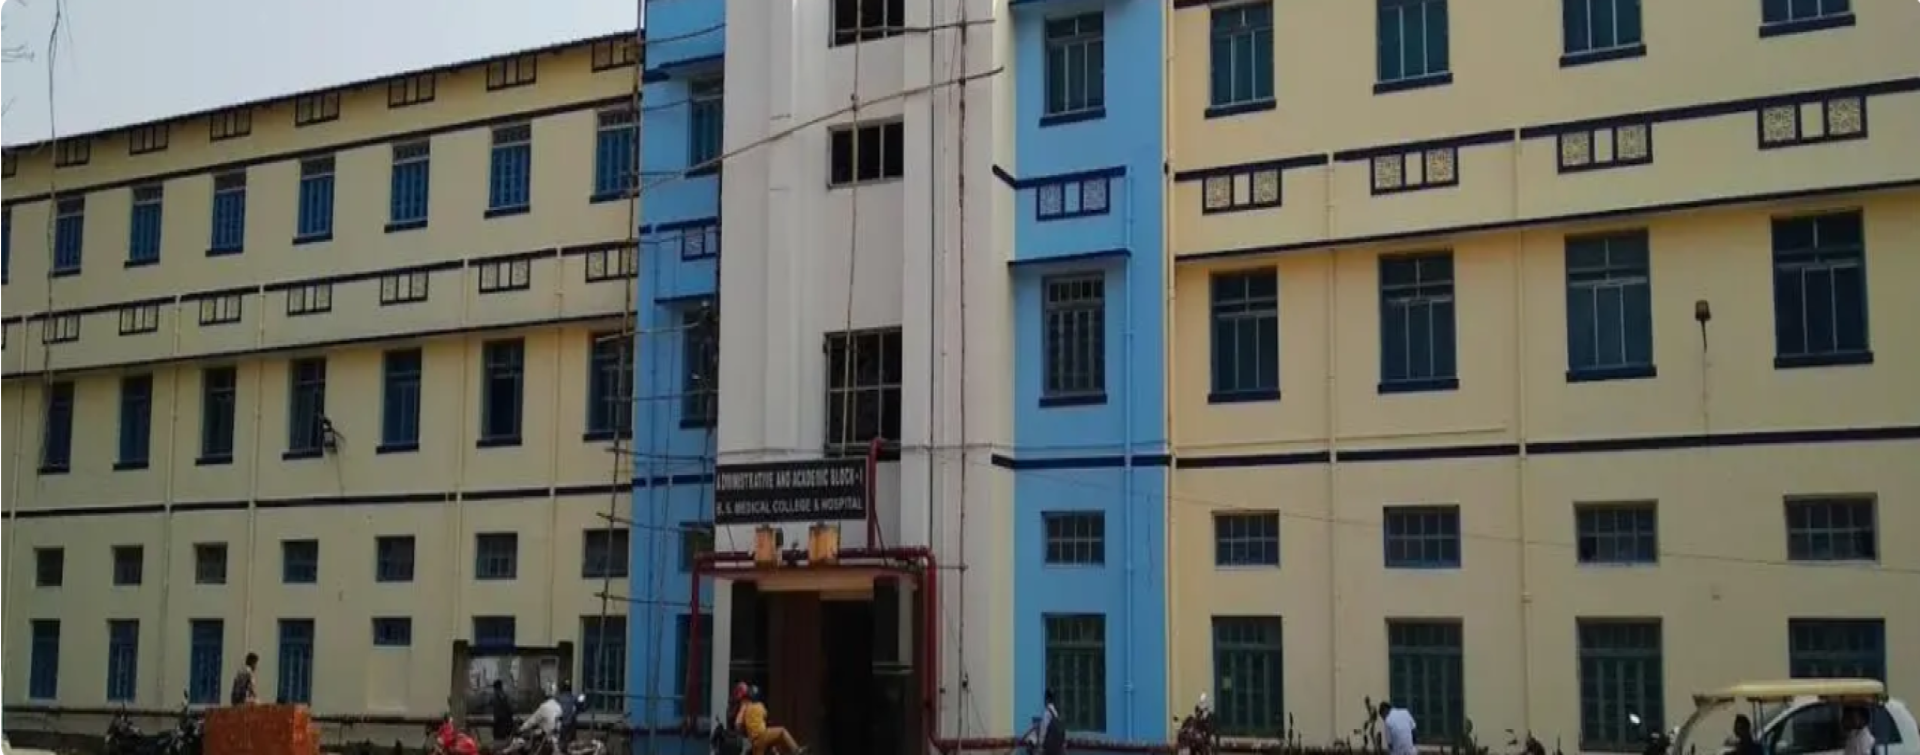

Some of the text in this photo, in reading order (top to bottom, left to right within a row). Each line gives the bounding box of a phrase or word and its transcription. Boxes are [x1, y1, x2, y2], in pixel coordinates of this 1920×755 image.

[776, 470, 790, 488] AND
[792, 468, 829, 487] ACADEMIC
[734, 500, 771, 515] MEDICAL
[772, 498, 811, 513] COLLEGE
[821, 496, 863, 511] HOSPITAL
